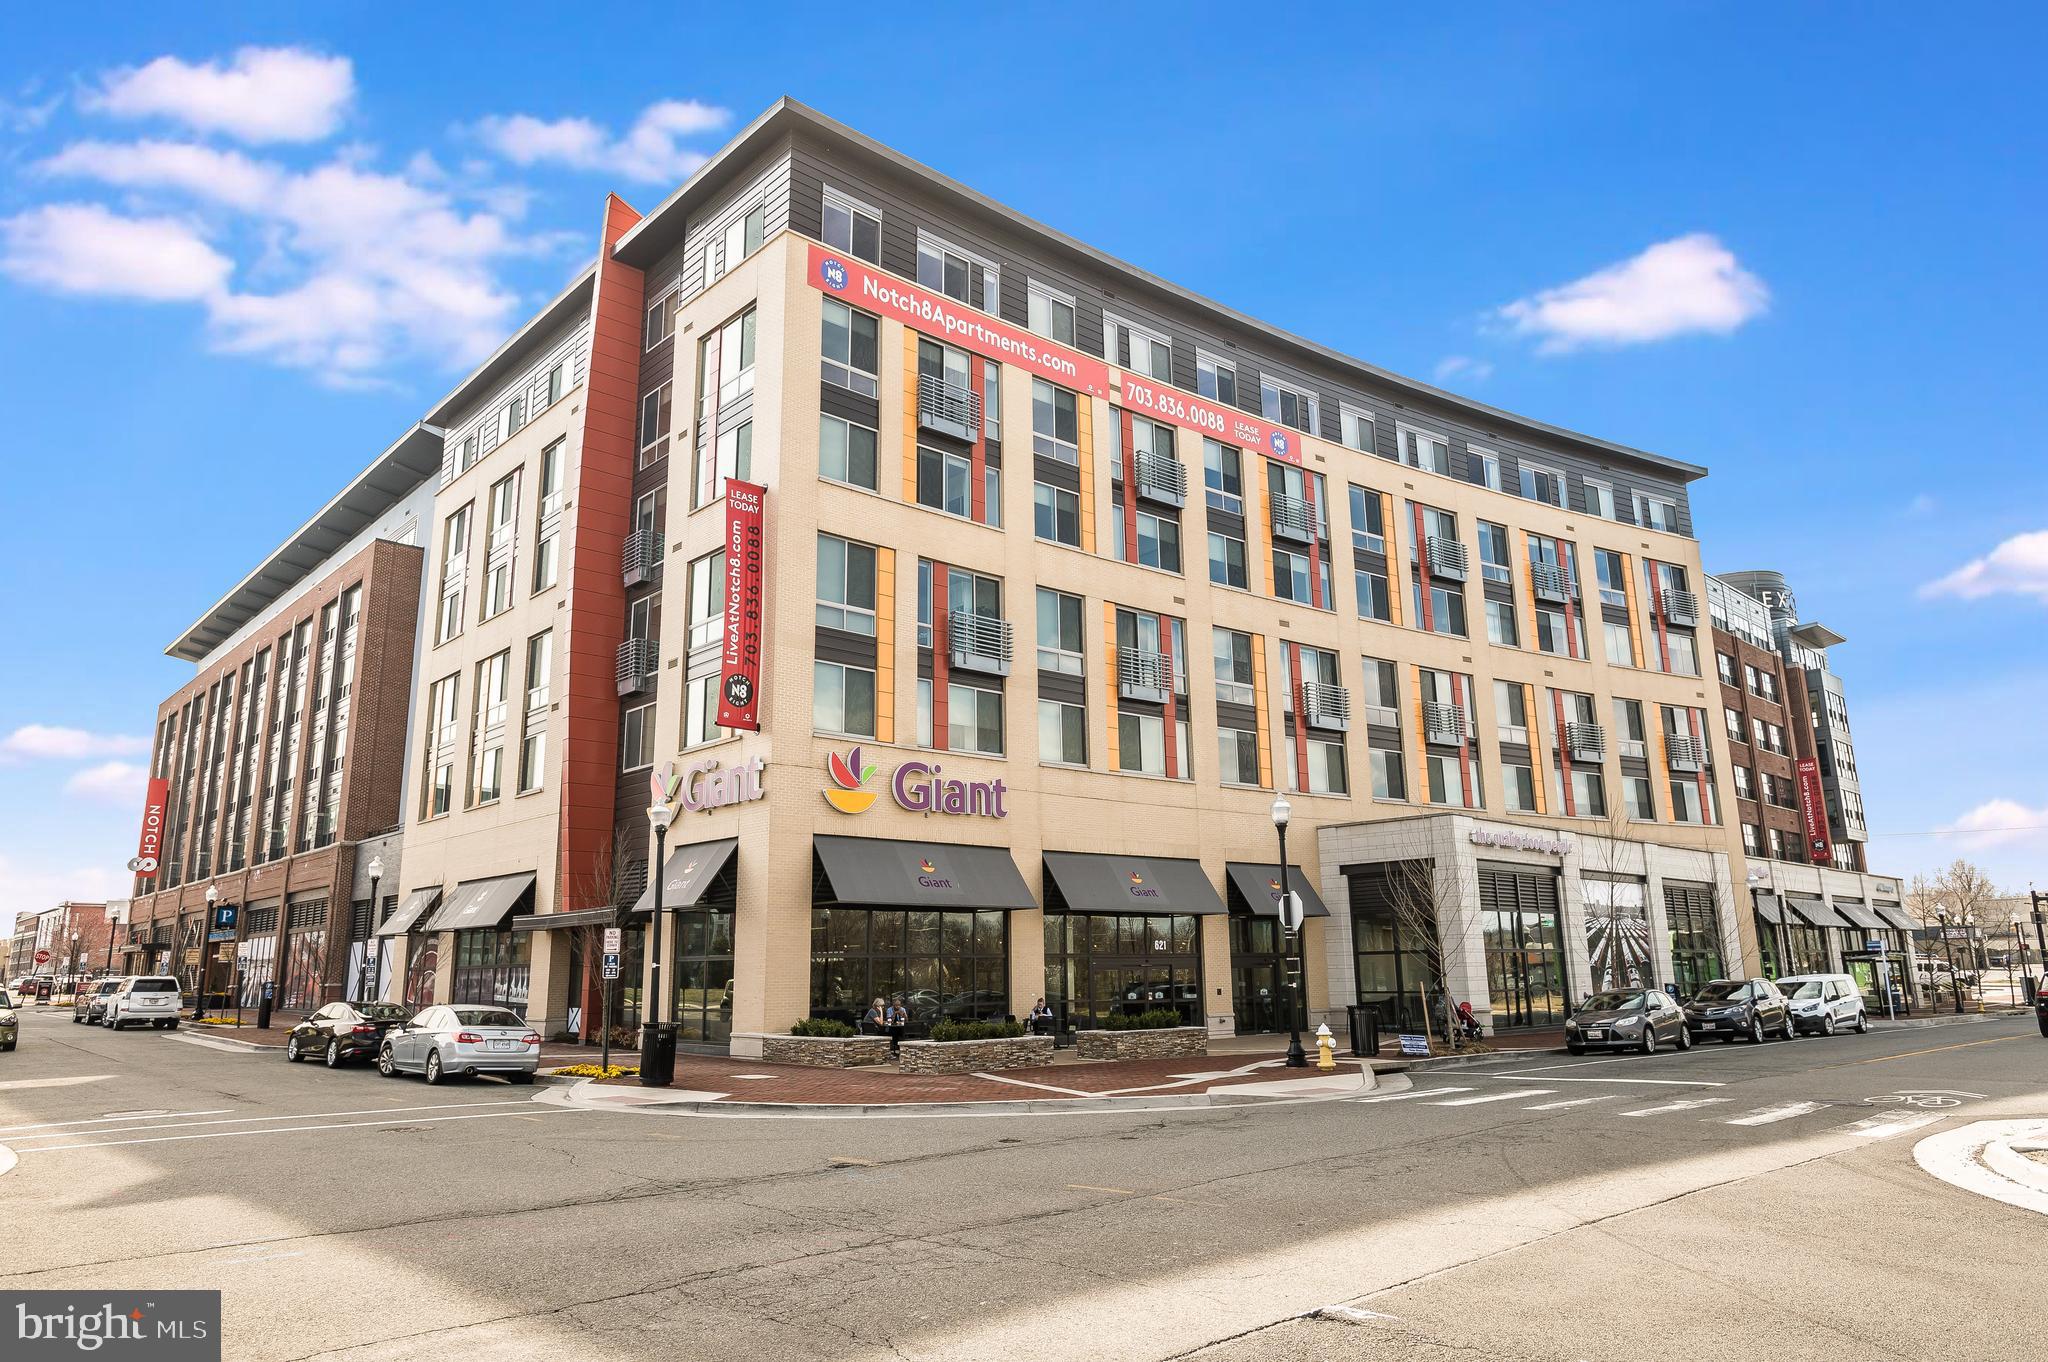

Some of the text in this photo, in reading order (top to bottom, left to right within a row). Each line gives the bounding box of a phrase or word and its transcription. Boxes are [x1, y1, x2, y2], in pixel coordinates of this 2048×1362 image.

[825, 260, 845, 272] NOTCH
[827, 267, 843, 283] N8
[825, 278, 844, 289] EIGHT
[863, 274, 1076, 377] Notch8Apartments.com
[1127, 381, 1225, 432] 703.836.0088
[1234, 421, 1260, 436] LEASE
[1234, 429, 1261, 445] TODAY
[1273, 437, 1285, 450] N8
[731, 489, 759, 504] LEASE
[730, 499, 760, 514] TODAY
[726, 520, 742, 665] LiveAtNotch8.com
[744, 525, 760, 667] 703.836.0088
[729, 675, 750, 686] NOTCH
[731, 684, 747, 699] N8
[729, 697, 748, 706] EIGHT
[681, 757, 765, 813] Giant
[892, 761, 1008, 818] Giant
[1802, 775, 1817, 837] LiveAtNotch8.com
[143, 804, 162, 854] NOTCH
[918, 876, 953, 889] Giant
[1130, 886, 1159, 898] Giant
[222, 909, 232, 922] P
[1154, 940, 1167, 950] 621
[35, 952, 50, 960] STOP
